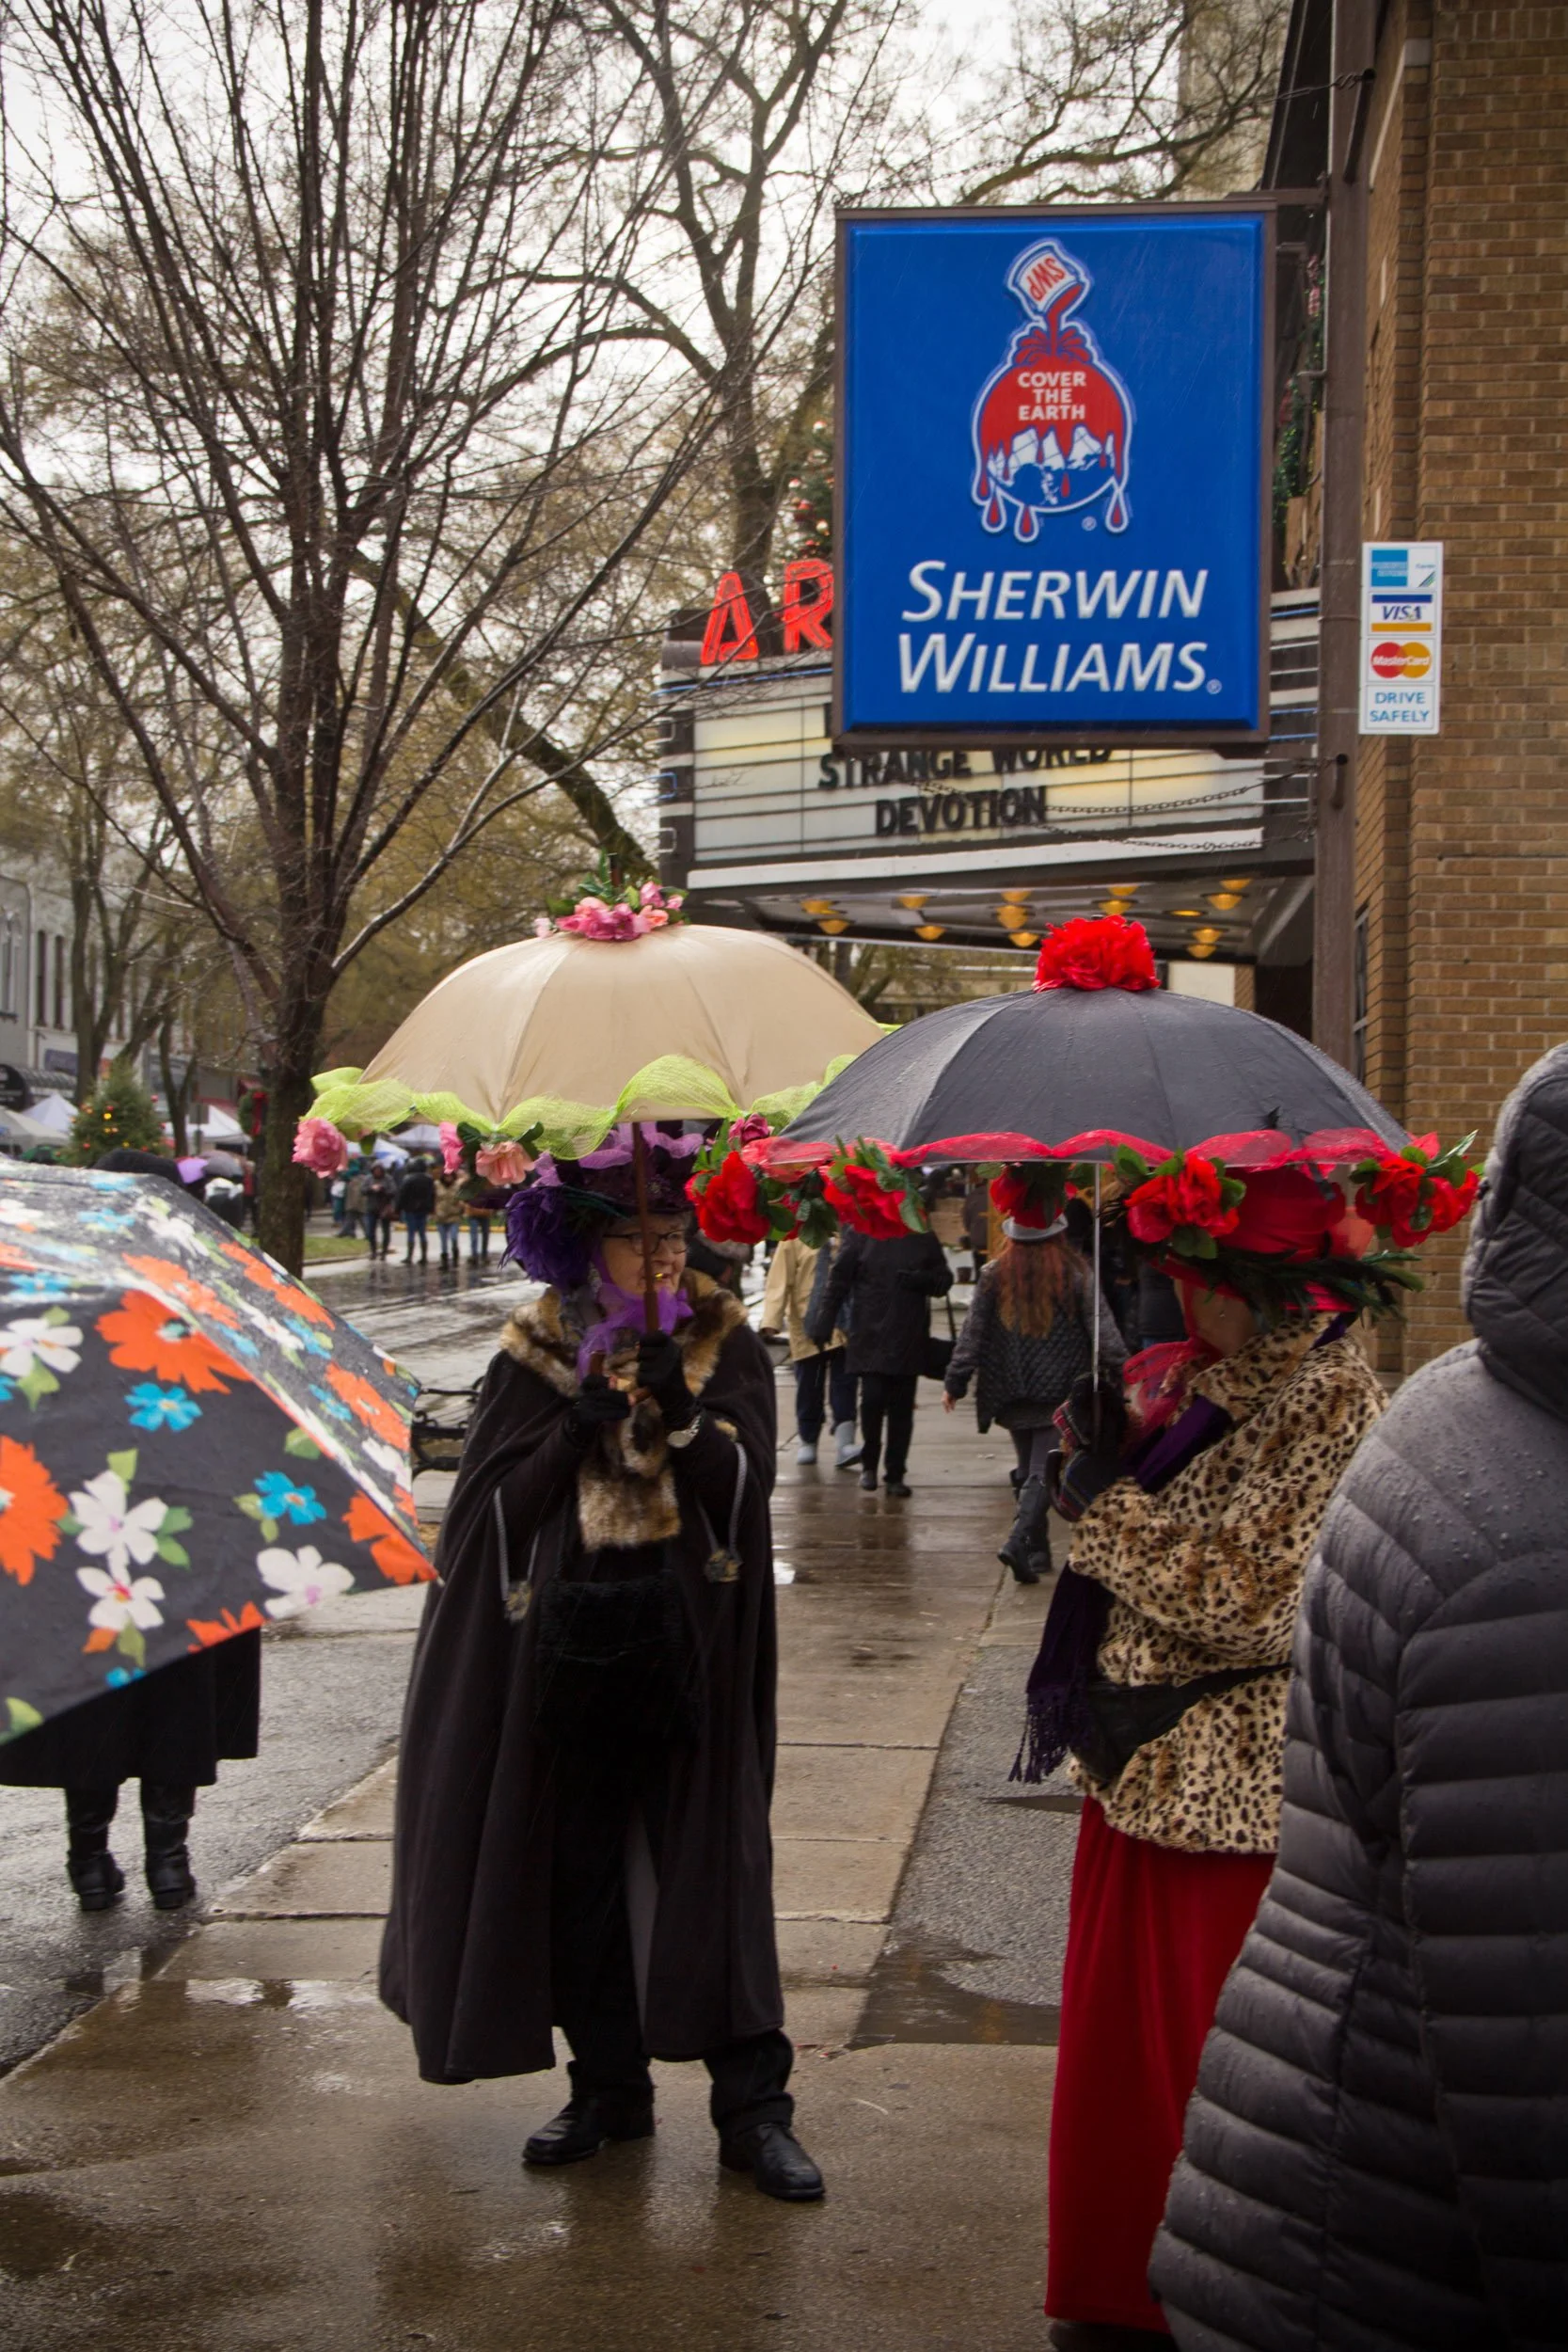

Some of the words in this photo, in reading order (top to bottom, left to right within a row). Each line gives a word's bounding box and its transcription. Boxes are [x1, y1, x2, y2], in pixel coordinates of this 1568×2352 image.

[1027, 258, 1065, 301] SWP
[1018, 372, 1086, 388] COVER
[1033, 389, 1072, 404] THE
[1018, 405, 1085, 421] EARTH
[901, 560, 1209, 623] SHERWIN
[1383, 605, 1422, 621] VISA
[898, 632, 1208, 692] WILLIAMS
[1374, 691, 1426, 705] DRIVE
[1370, 709, 1430, 723] SAFELY
[818, 750, 973, 789] STRANGE
[876, 786, 1046, 835] DEVOTION
